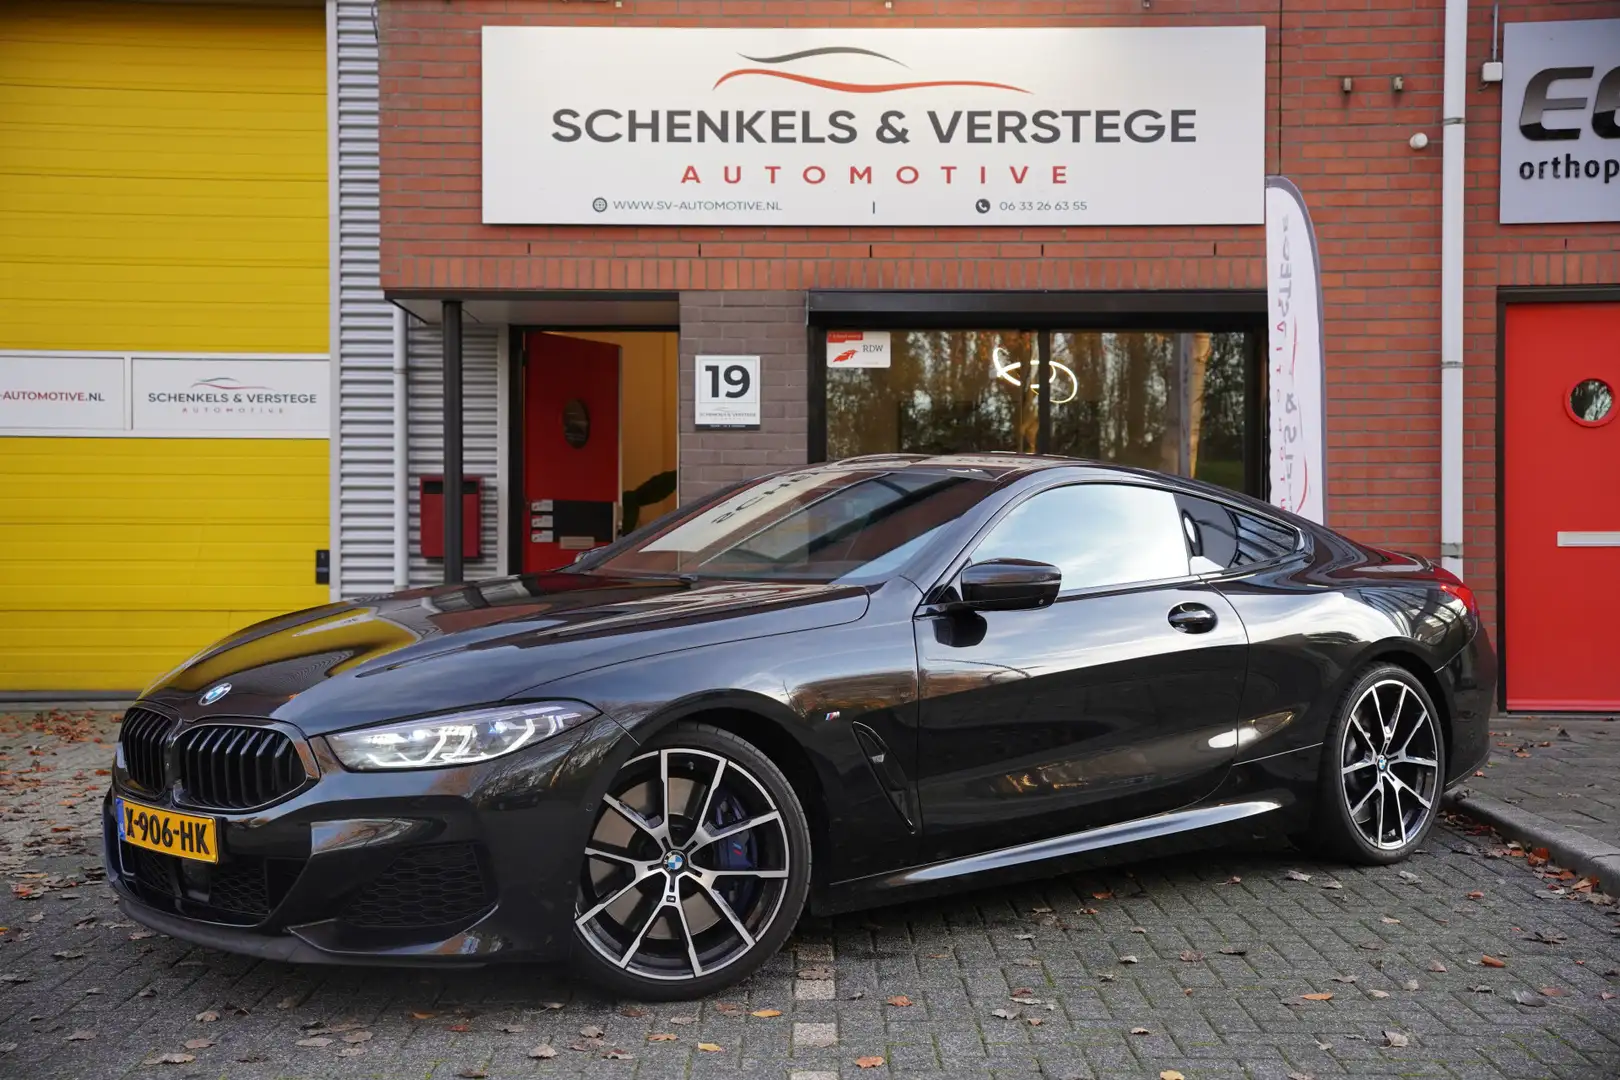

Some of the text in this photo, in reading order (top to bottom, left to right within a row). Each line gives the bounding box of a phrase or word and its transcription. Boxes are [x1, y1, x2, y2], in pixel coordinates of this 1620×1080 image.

[552, 108, 1197, 144] SCHENKELS & VERSTEGE
[680, 165, 1067, 185] AUTOMOTIVE
[1519, 153, 1620, 184] orthop
[613, 200, 783, 211] WWW.SV-AUTOMOTIVE.NL
[1000, 201, 1088, 211] 06 33 26 63 55
[862, 344, 884, 353] RDW
[705, 364, 750, 399] 19
[148, 392, 318, 404] SCHENKELS & VERSTEGE
[125, 806, 210, 855] X-906-HK
